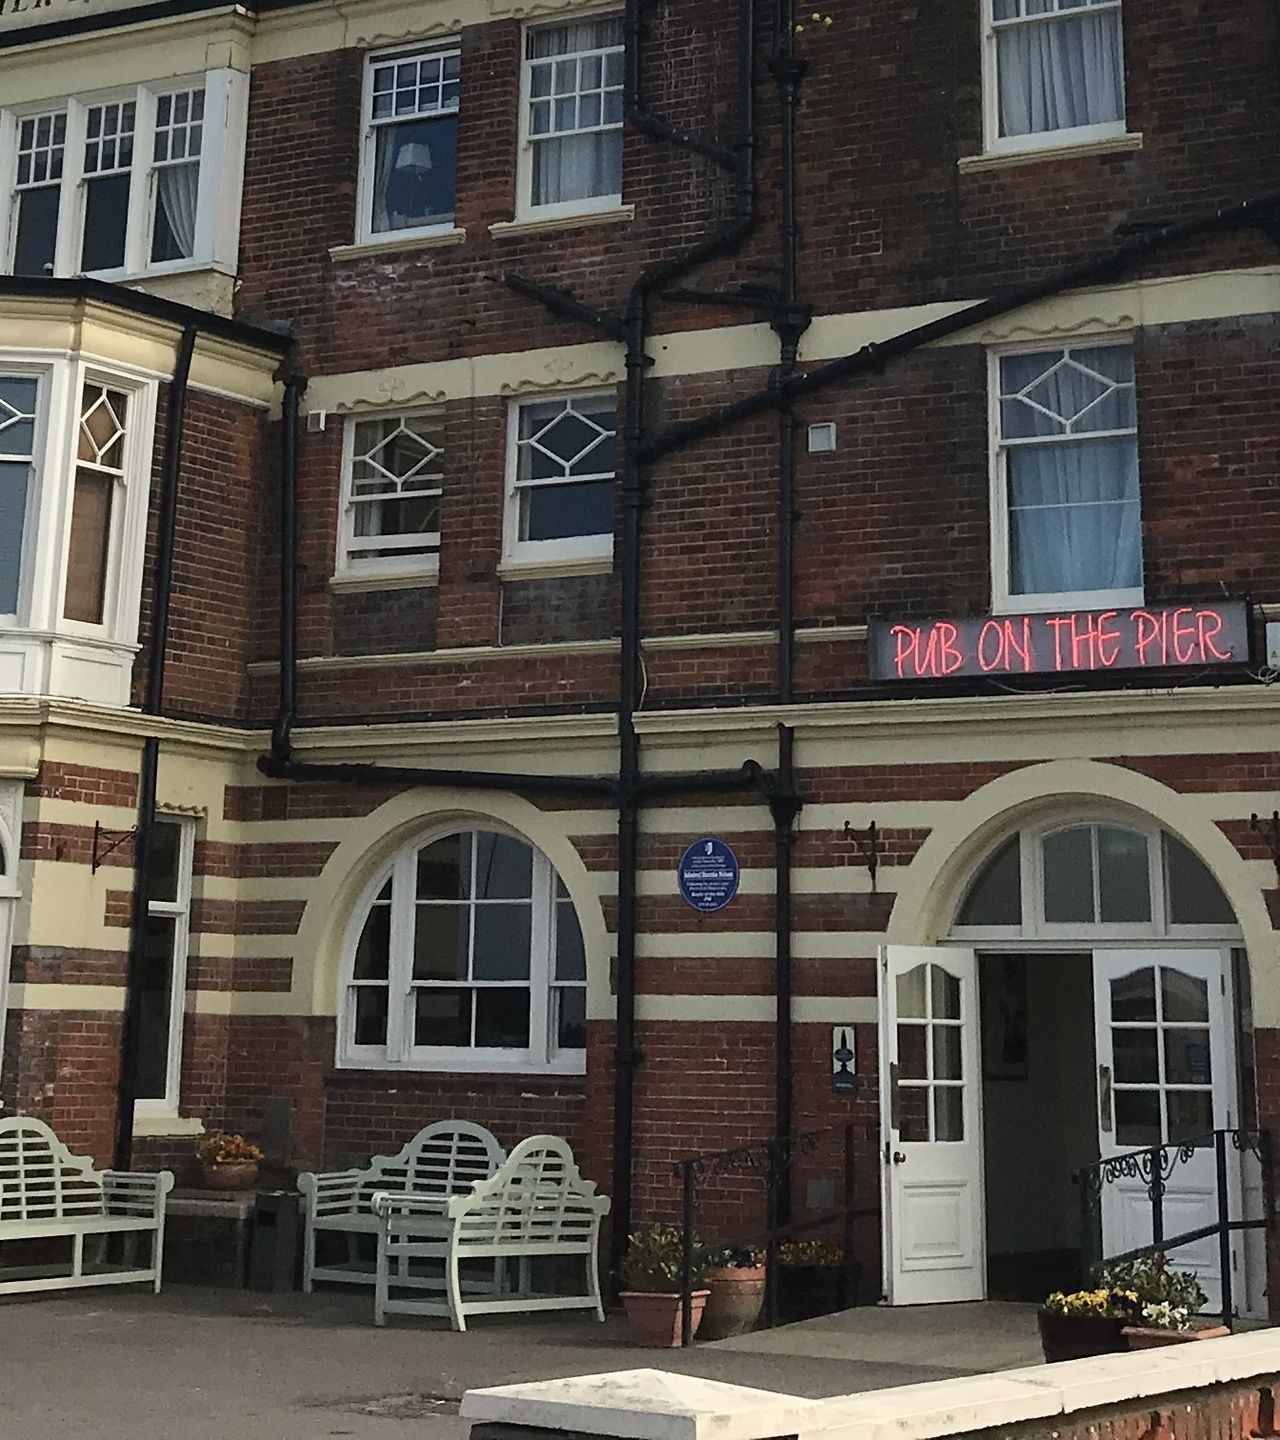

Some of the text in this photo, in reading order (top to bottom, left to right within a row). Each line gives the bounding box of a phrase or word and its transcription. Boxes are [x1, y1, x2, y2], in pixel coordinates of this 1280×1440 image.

[889, 608, 1232, 678] PUB ON THE PIER
